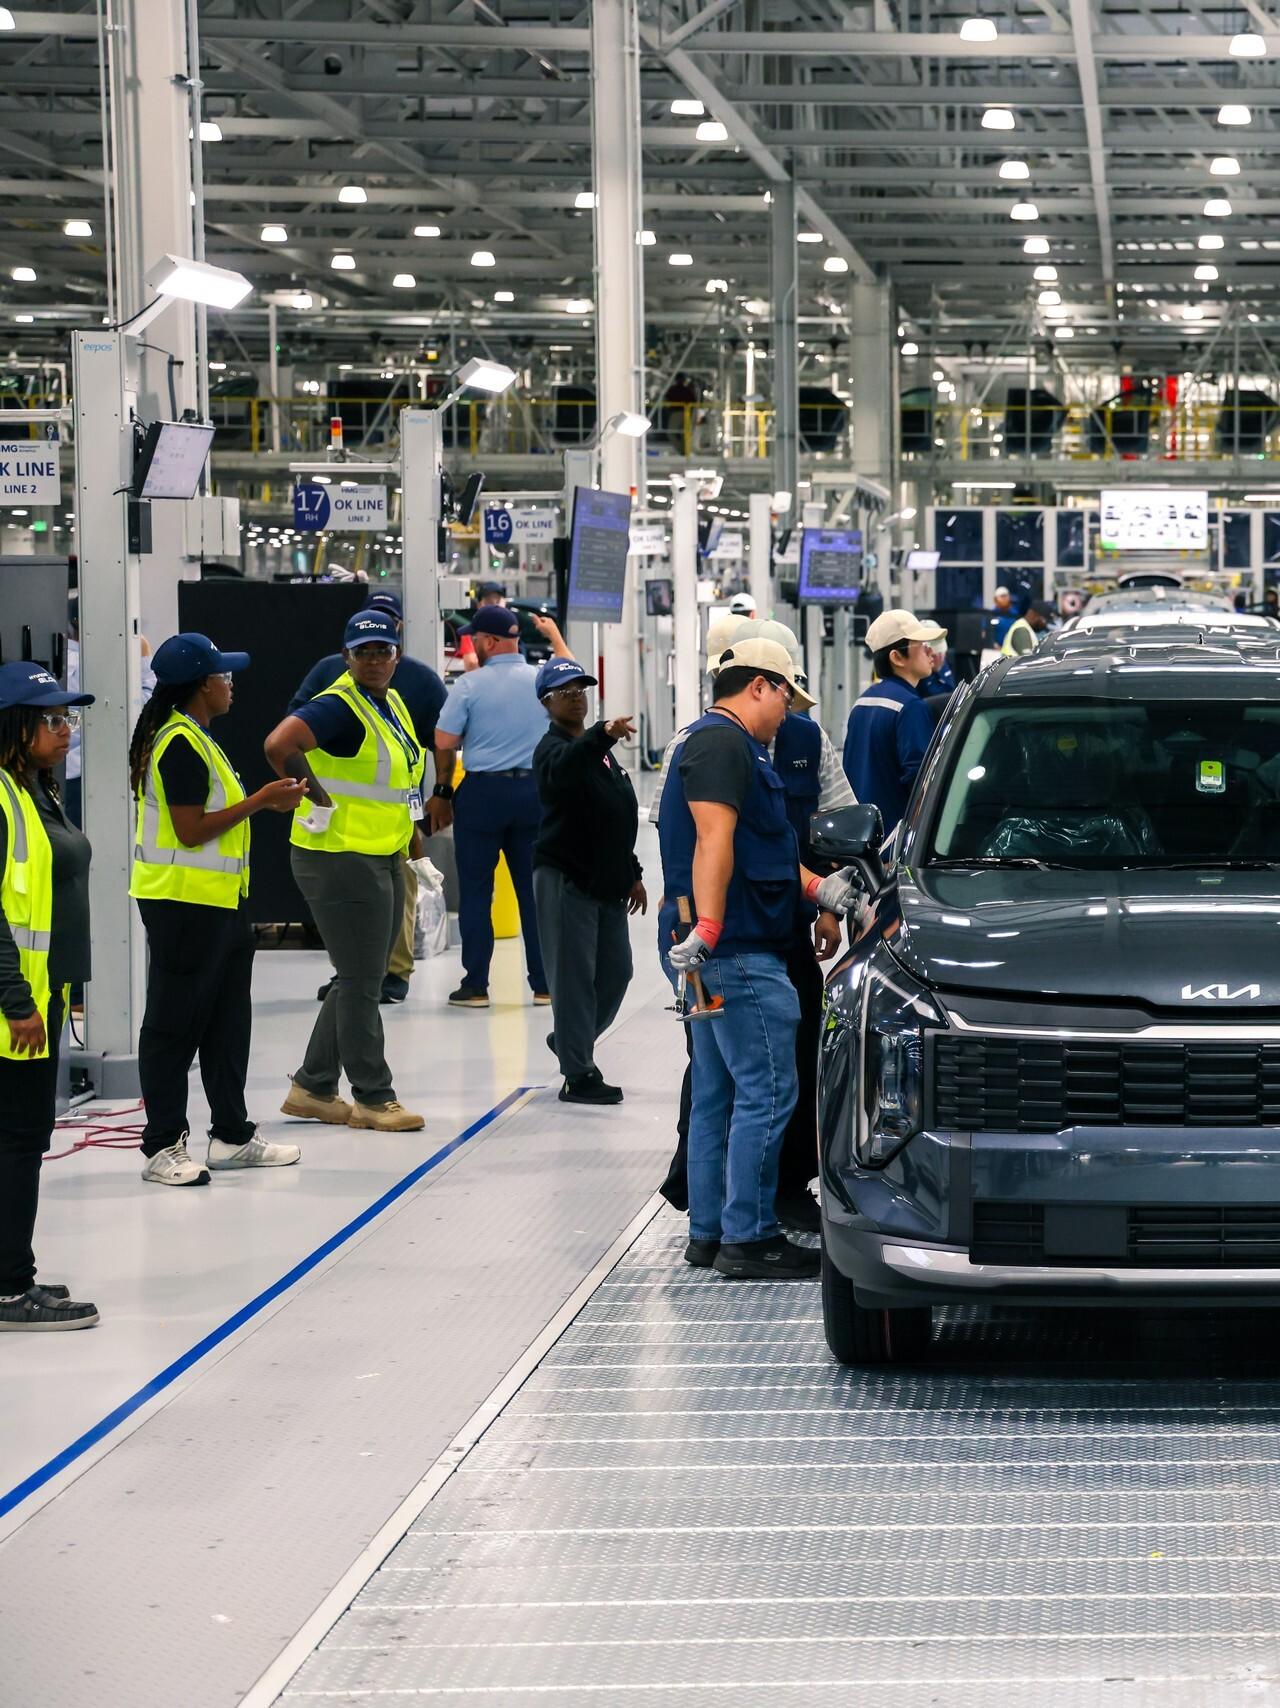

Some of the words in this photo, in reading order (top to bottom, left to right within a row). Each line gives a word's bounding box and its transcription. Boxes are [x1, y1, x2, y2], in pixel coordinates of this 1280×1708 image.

[83, 342, 113, 353] eepos
[0, 445, 18, 453] MG
[0, 462, 10, 477] K
[16, 462, 55, 477] LINE
[4, 484, 28, 494] LINE
[30, 484, 37, 494] 2
[297, 490, 325, 512] 17
[334, 499, 353, 511] OK
[357, 499, 384, 511] LINE
[304, 513, 318, 522] RH
[487, 513, 510, 531] 16
[515, 520, 530, 529] OK
[532, 520, 553, 529] LINE
[1181, 983, 1261, 1000] KIA
